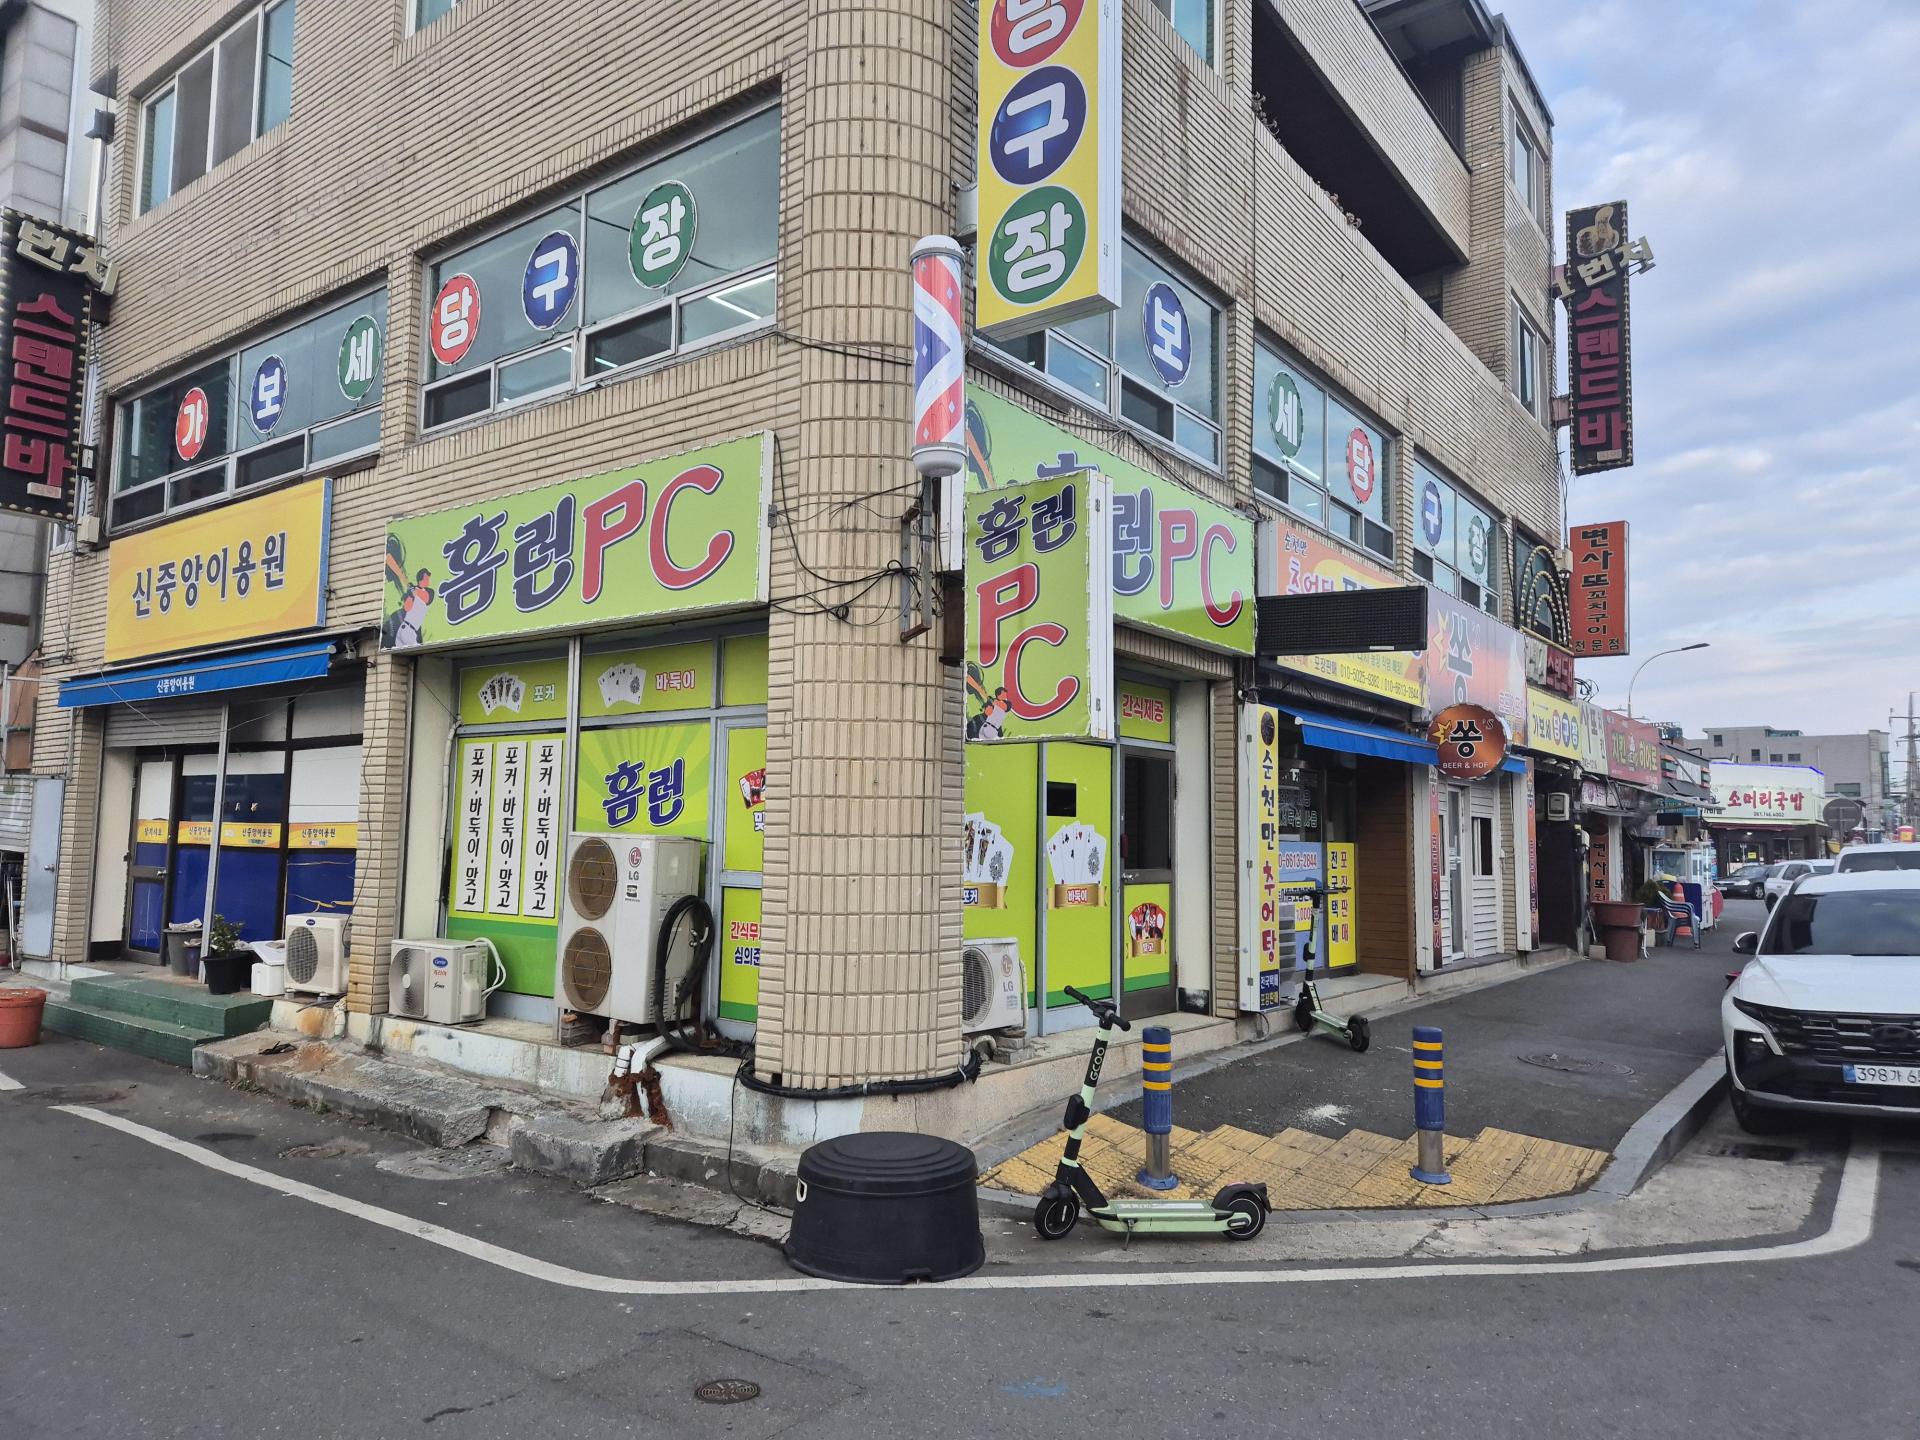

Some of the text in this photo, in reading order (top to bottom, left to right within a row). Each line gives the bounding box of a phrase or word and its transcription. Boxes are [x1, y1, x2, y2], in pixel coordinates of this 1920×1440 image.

[1576, 288, 1628, 450] 스탠드바
[3, 293, 76, 487] 스탠드바
[975, 483, 1078, 564] 홈런
[1036, 451, 1243, 627] 런PC
[437, 464, 736, 625] 홈런PC
[1581, 527, 1613, 588] 변사또
[132, 531, 287, 618] 신중앙이용원
[1586, 590, 1608, 635] 꼬치구이
[975, 562, 1081, 721] PC
[1575, 638, 1619, 653] 전문점
[156, 675, 196, 694] 신중앙이용원
[533, 684, 555, 702] 포커
[655, 669, 696, 691] 바둑이
[1121, 692, 1165, 724] 간식제공
[602, 756, 686, 828] 홈런
[1261, 749, 1277, 850] 순천만
[1727, 790, 1805, 811] 소머리국밥
[188, 826, 212, 836] 신중앙이용
[628, 870, 640, 881] LG
[1066, 888, 1089, 903] 바둑이
[1261, 860, 1278, 962] 추어탕
[730, 921, 761, 941] 간식무
[1002, 980, 1014, 992] LG
[1089, 1047, 1105, 1081] GCOO
[1857, 1067, 1902, 1083] 398가
